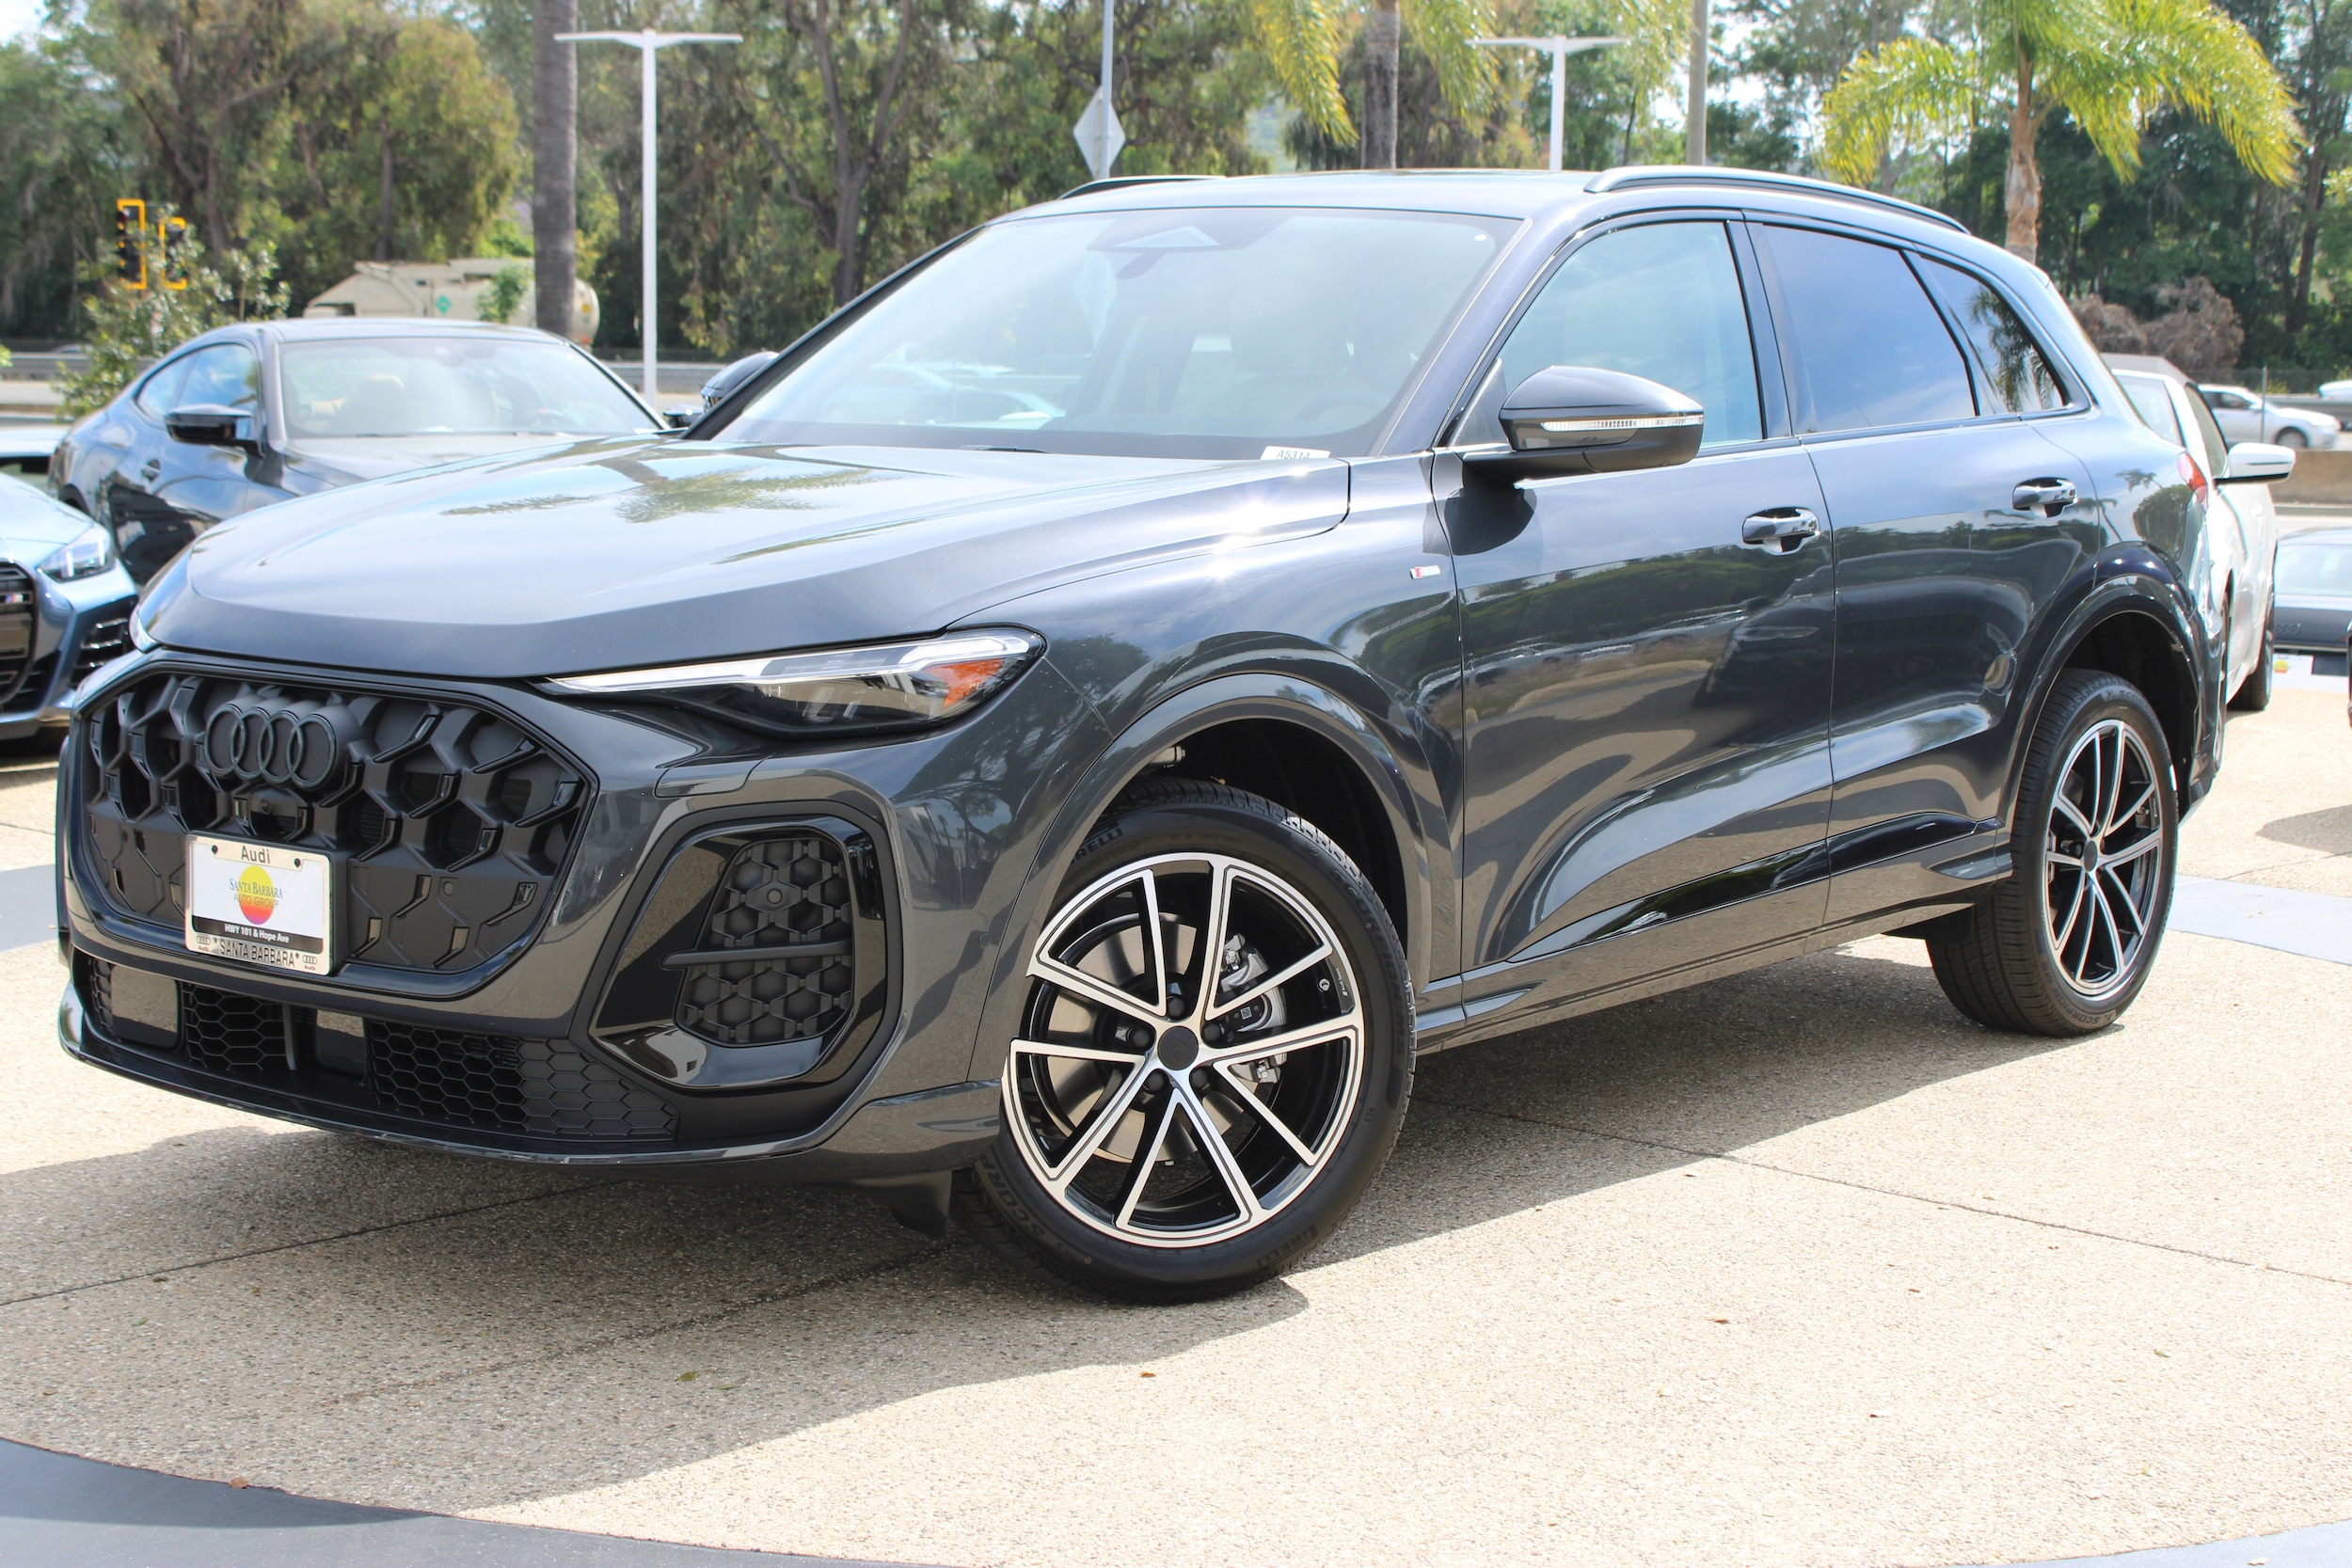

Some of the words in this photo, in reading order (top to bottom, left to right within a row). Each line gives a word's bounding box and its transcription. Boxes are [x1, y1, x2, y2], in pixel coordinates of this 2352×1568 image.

[1070, 822, 1124, 864] RELLI
[241, 845, 271, 864] Audi
[229, 878, 252, 894] SANTA
[252, 881, 283, 899] BARBARA
[233, 894, 253, 905] AUTO
[253, 896, 279, 909] GROUP
[224, 924, 240, 934] HWY
[241, 926, 253, 937] 101
[253, 927, 259, 938] &
[259, 930, 277, 942] Hope
[278, 932, 290, 943] Ave
[219, 939, 250, 959] SANTA
[251, 944, 295, 967] BARBARA
